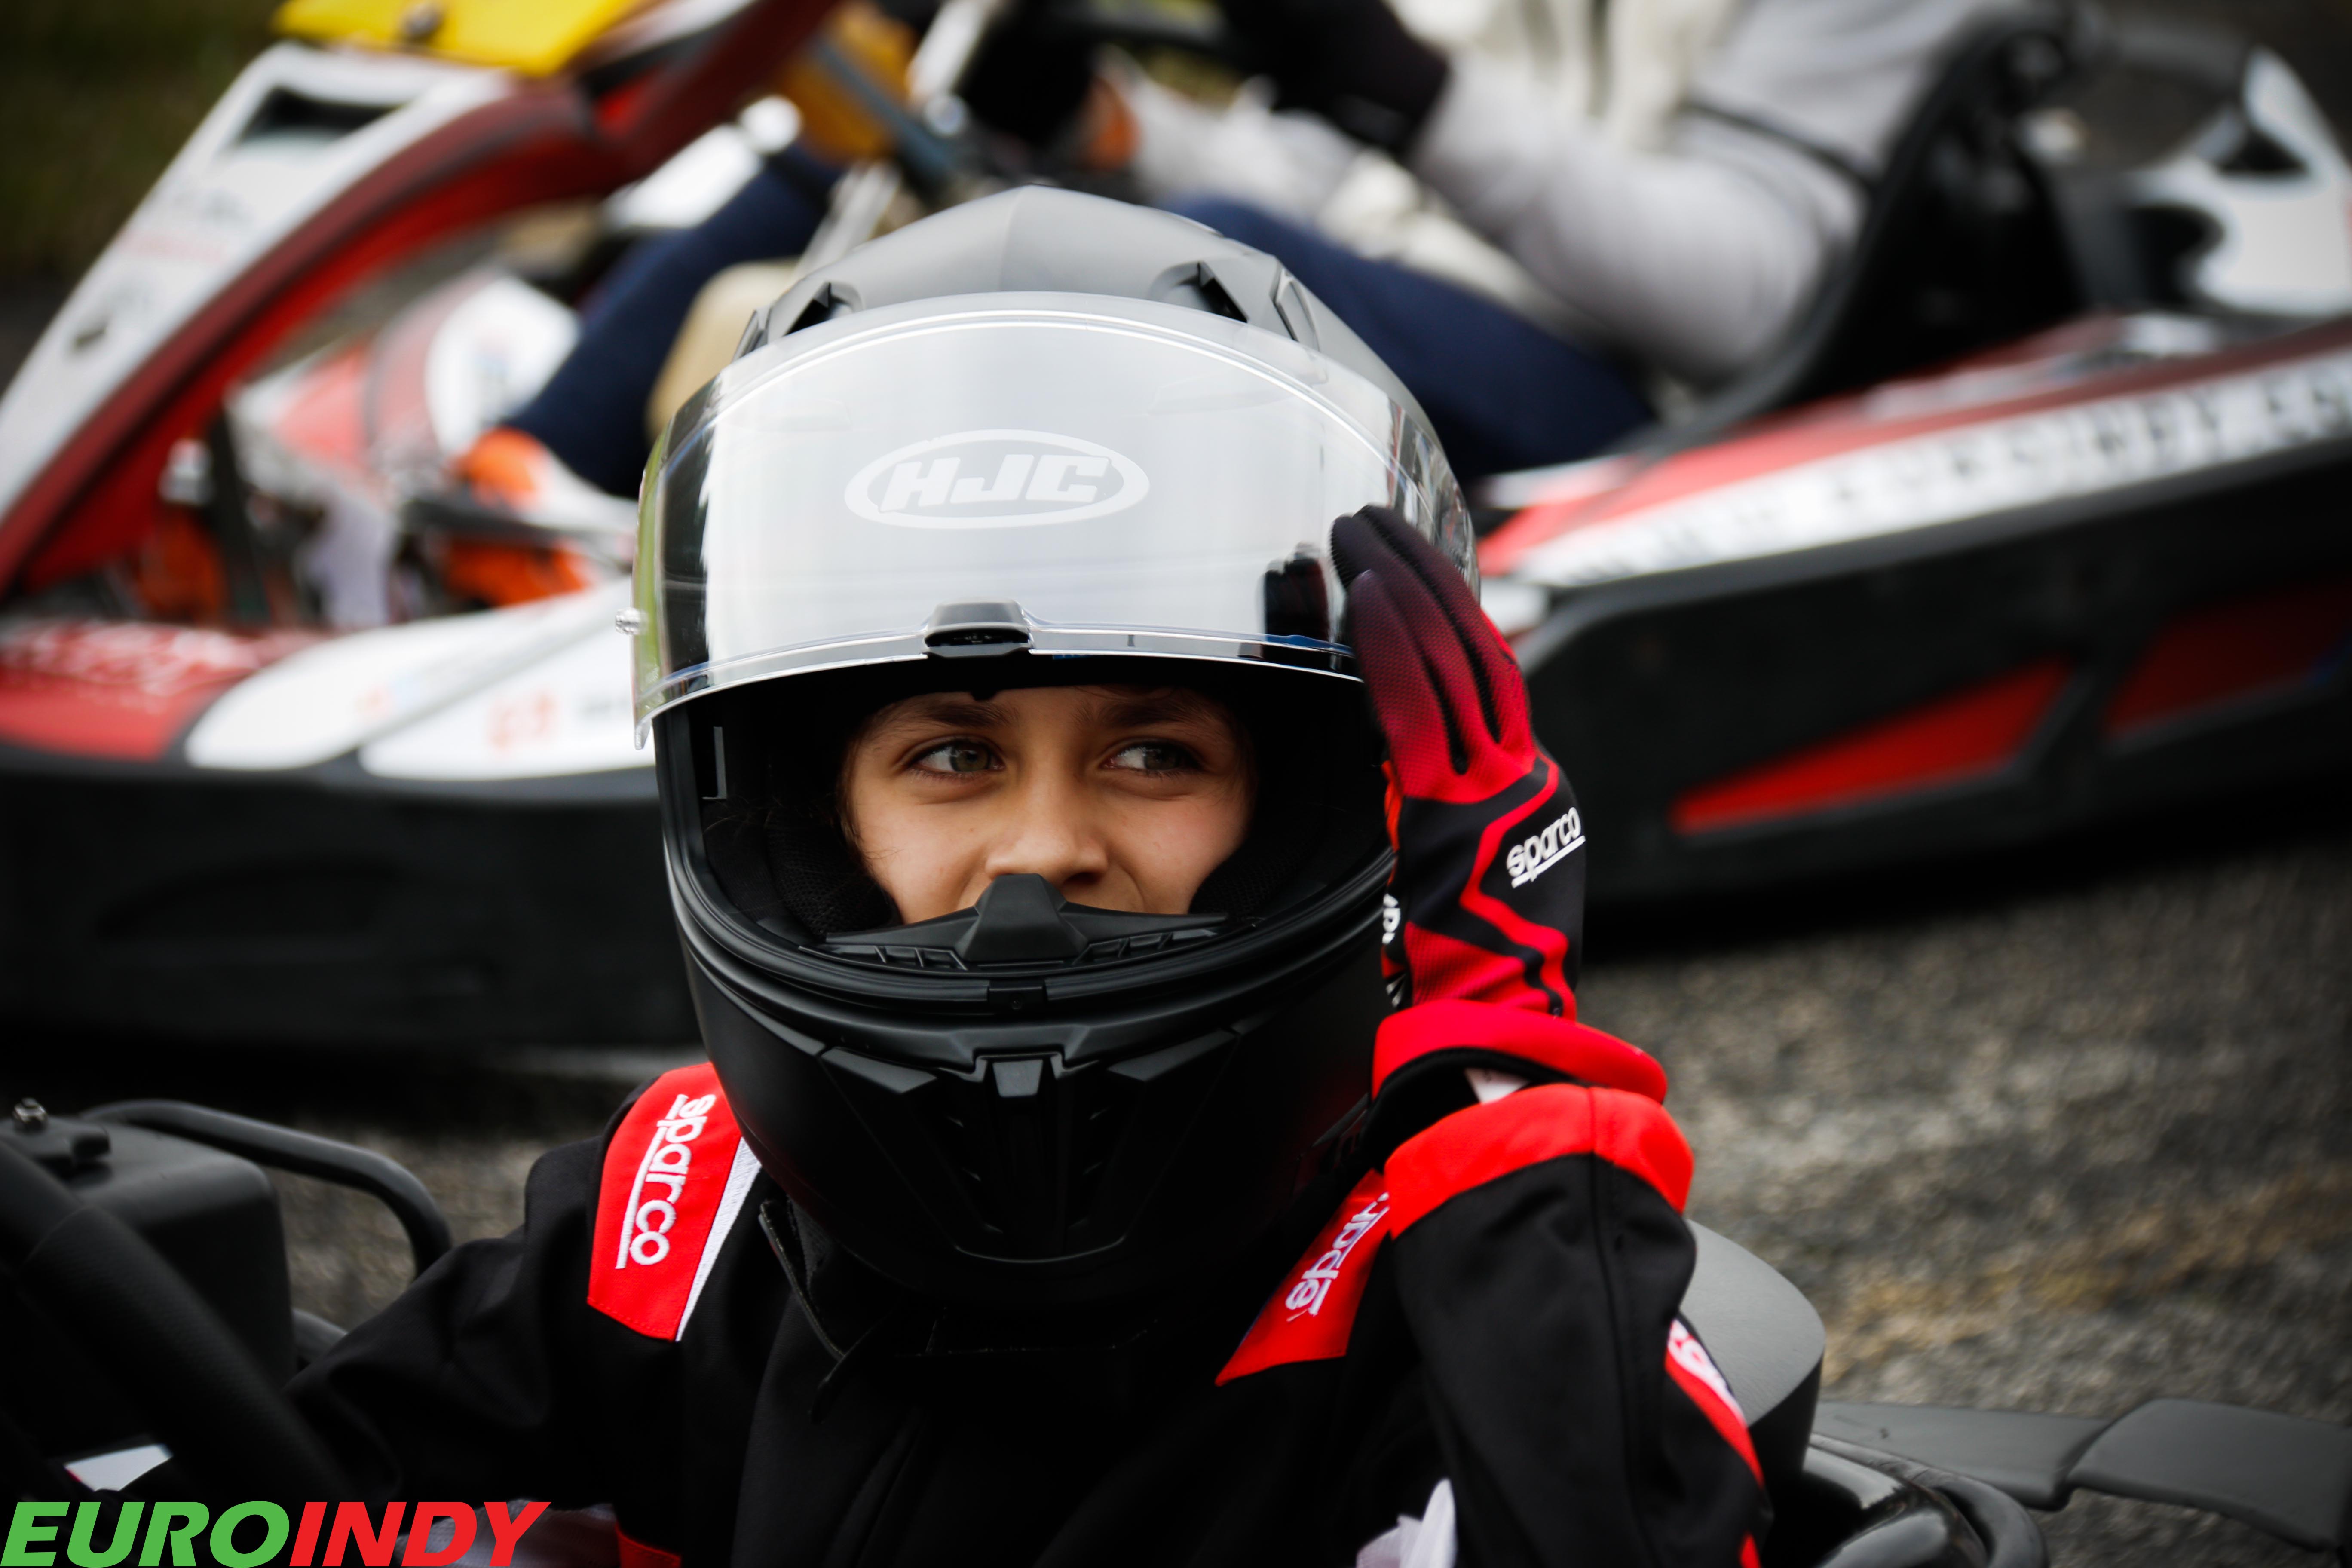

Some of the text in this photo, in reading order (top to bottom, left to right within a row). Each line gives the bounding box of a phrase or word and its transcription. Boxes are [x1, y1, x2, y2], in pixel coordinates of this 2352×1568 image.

[880, 454, 1110, 512] HJC
[1506, 807, 1583, 883] sparco
[629, 1094, 716, 1266] sparco
[1285, 1191, 1390, 1315] spar
